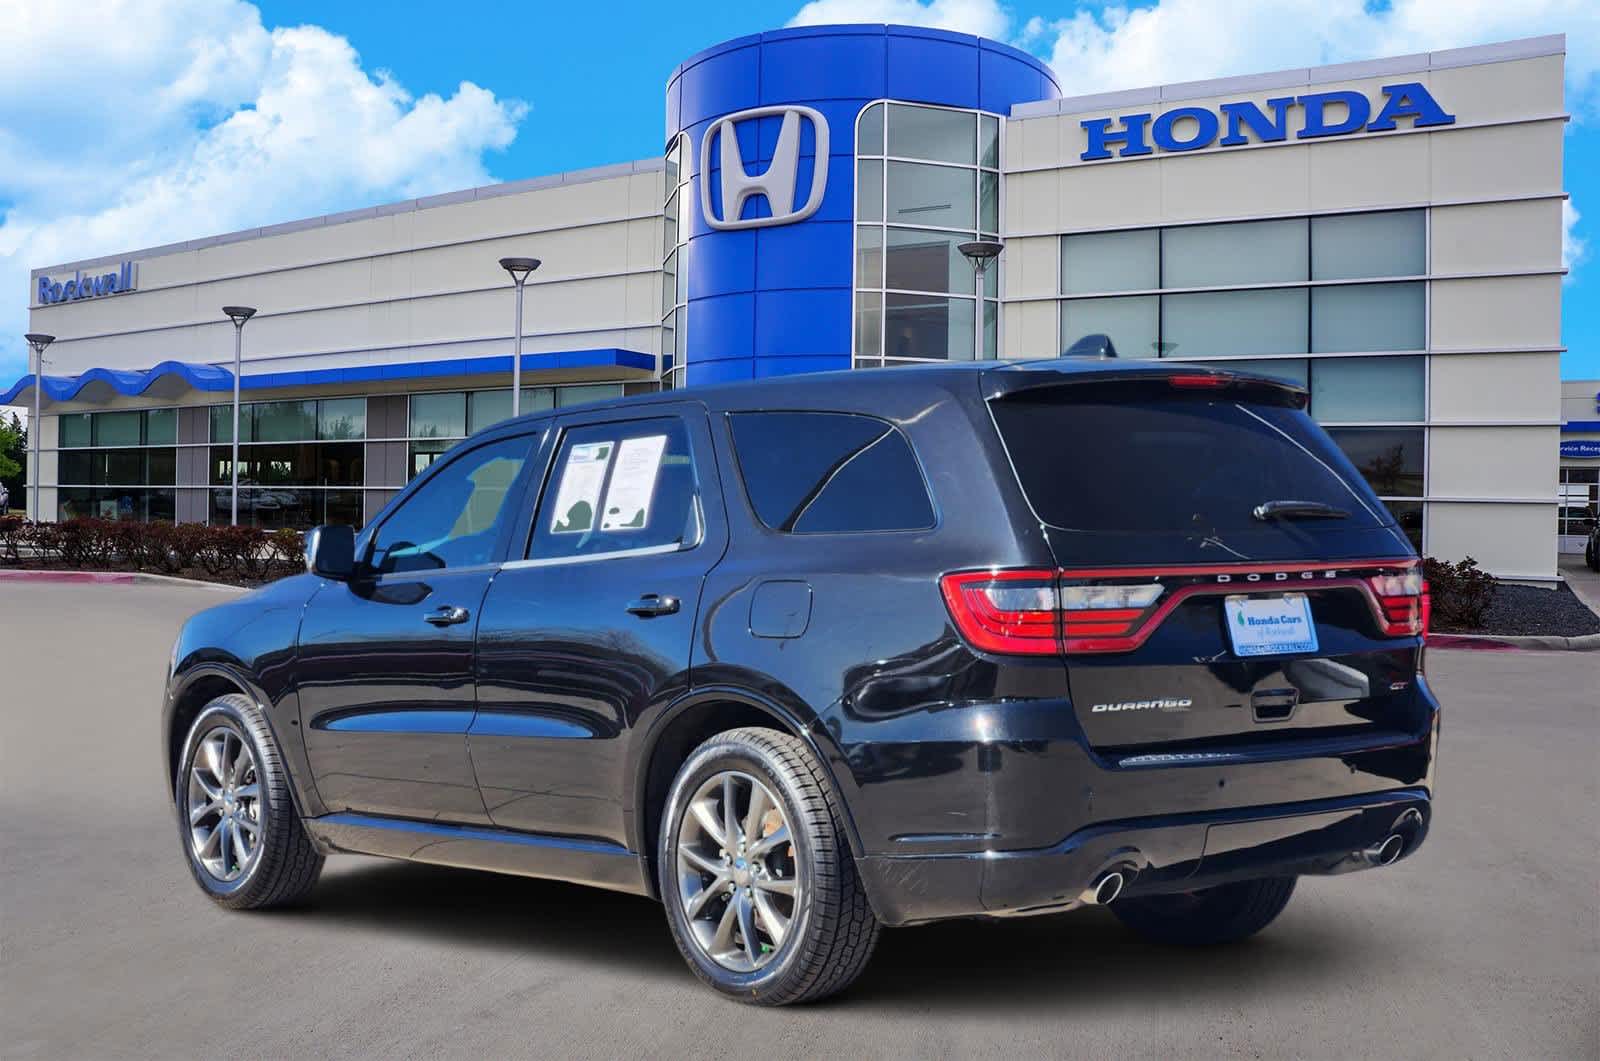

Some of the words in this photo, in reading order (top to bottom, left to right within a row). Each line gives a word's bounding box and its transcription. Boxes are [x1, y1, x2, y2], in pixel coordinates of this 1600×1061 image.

[1079, 82, 1456, 161] HONDA
[38, 261, 132, 304] Rockwall
[1217, 570, 1337, 583] DODGE
[1247, 616, 1280, 626] Honda
[1280, 615, 1302, 624] Cars
[1092, 699, 1192, 713] DURANGO
